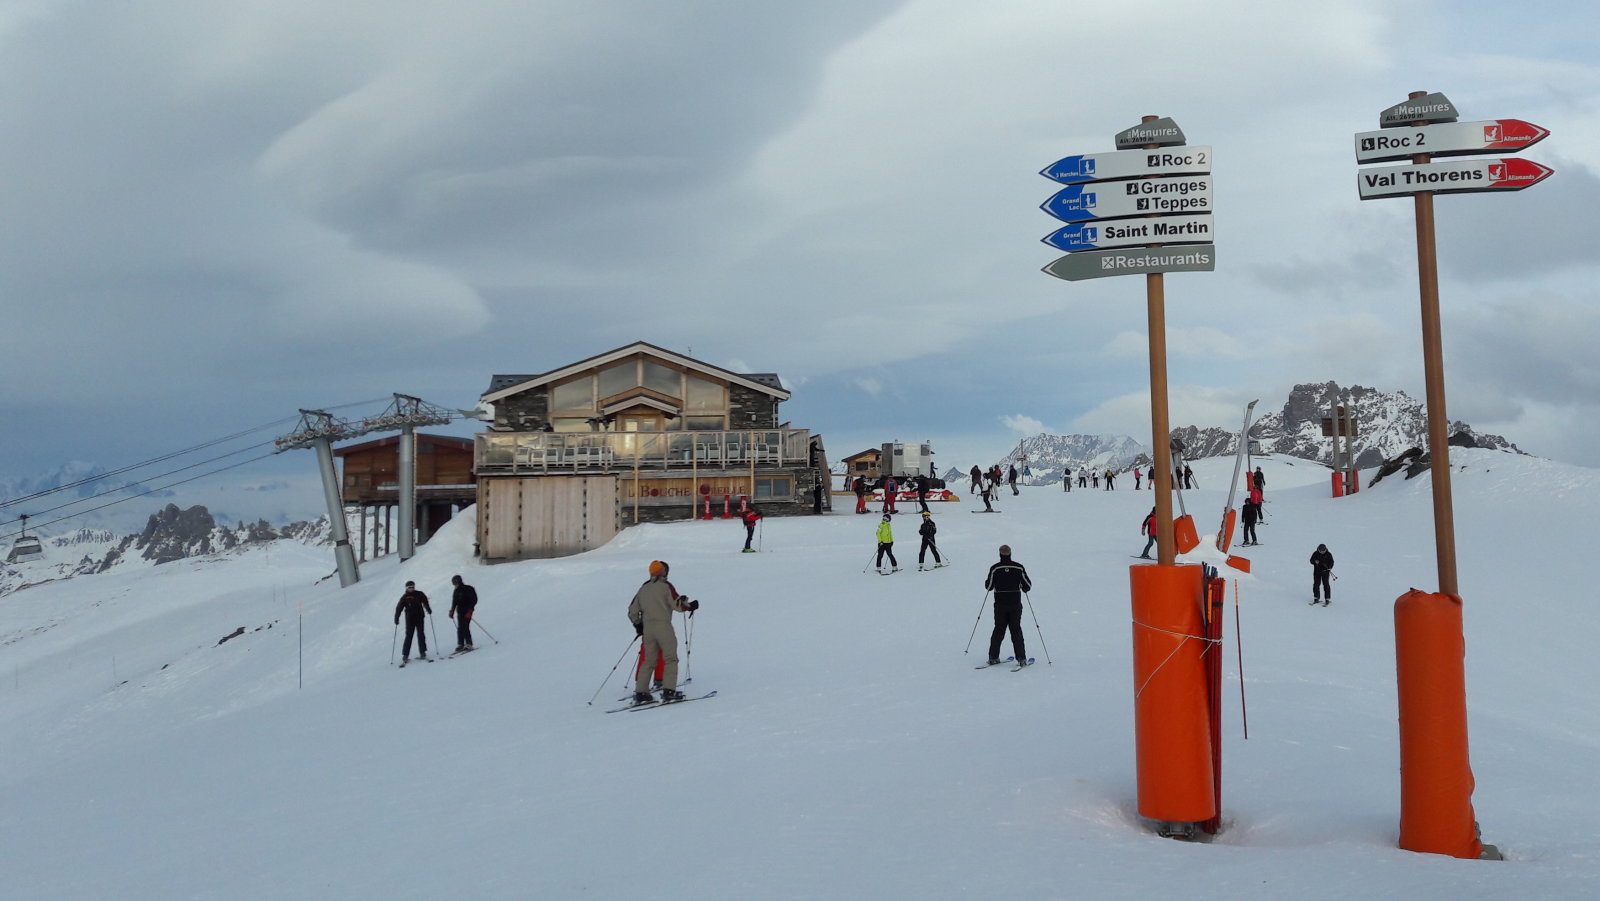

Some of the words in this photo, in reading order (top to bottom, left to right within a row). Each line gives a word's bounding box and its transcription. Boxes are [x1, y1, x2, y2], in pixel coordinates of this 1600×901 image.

[1398, 103, 1450, 114] Menuires
[1131, 127, 1178, 138] Menuires
[1377, 136, 1411, 149] Roc
[1416, 133, 1426, 145] 2
[1162, 154, 1192, 166] Roc
[1197, 153, 1206, 165] 2
[1365, 173, 1396, 188] Val
[1402, 168, 1483, 184] Thorens
[1141, 180, 1207, 197] Granges
[1152, 197, 1208, 211] Teppes
[1105, 225, 1148, 239] Saint
[1154, 222, 1209, 236] Martin
[1116, 252, 1210, 268] Restaurants
